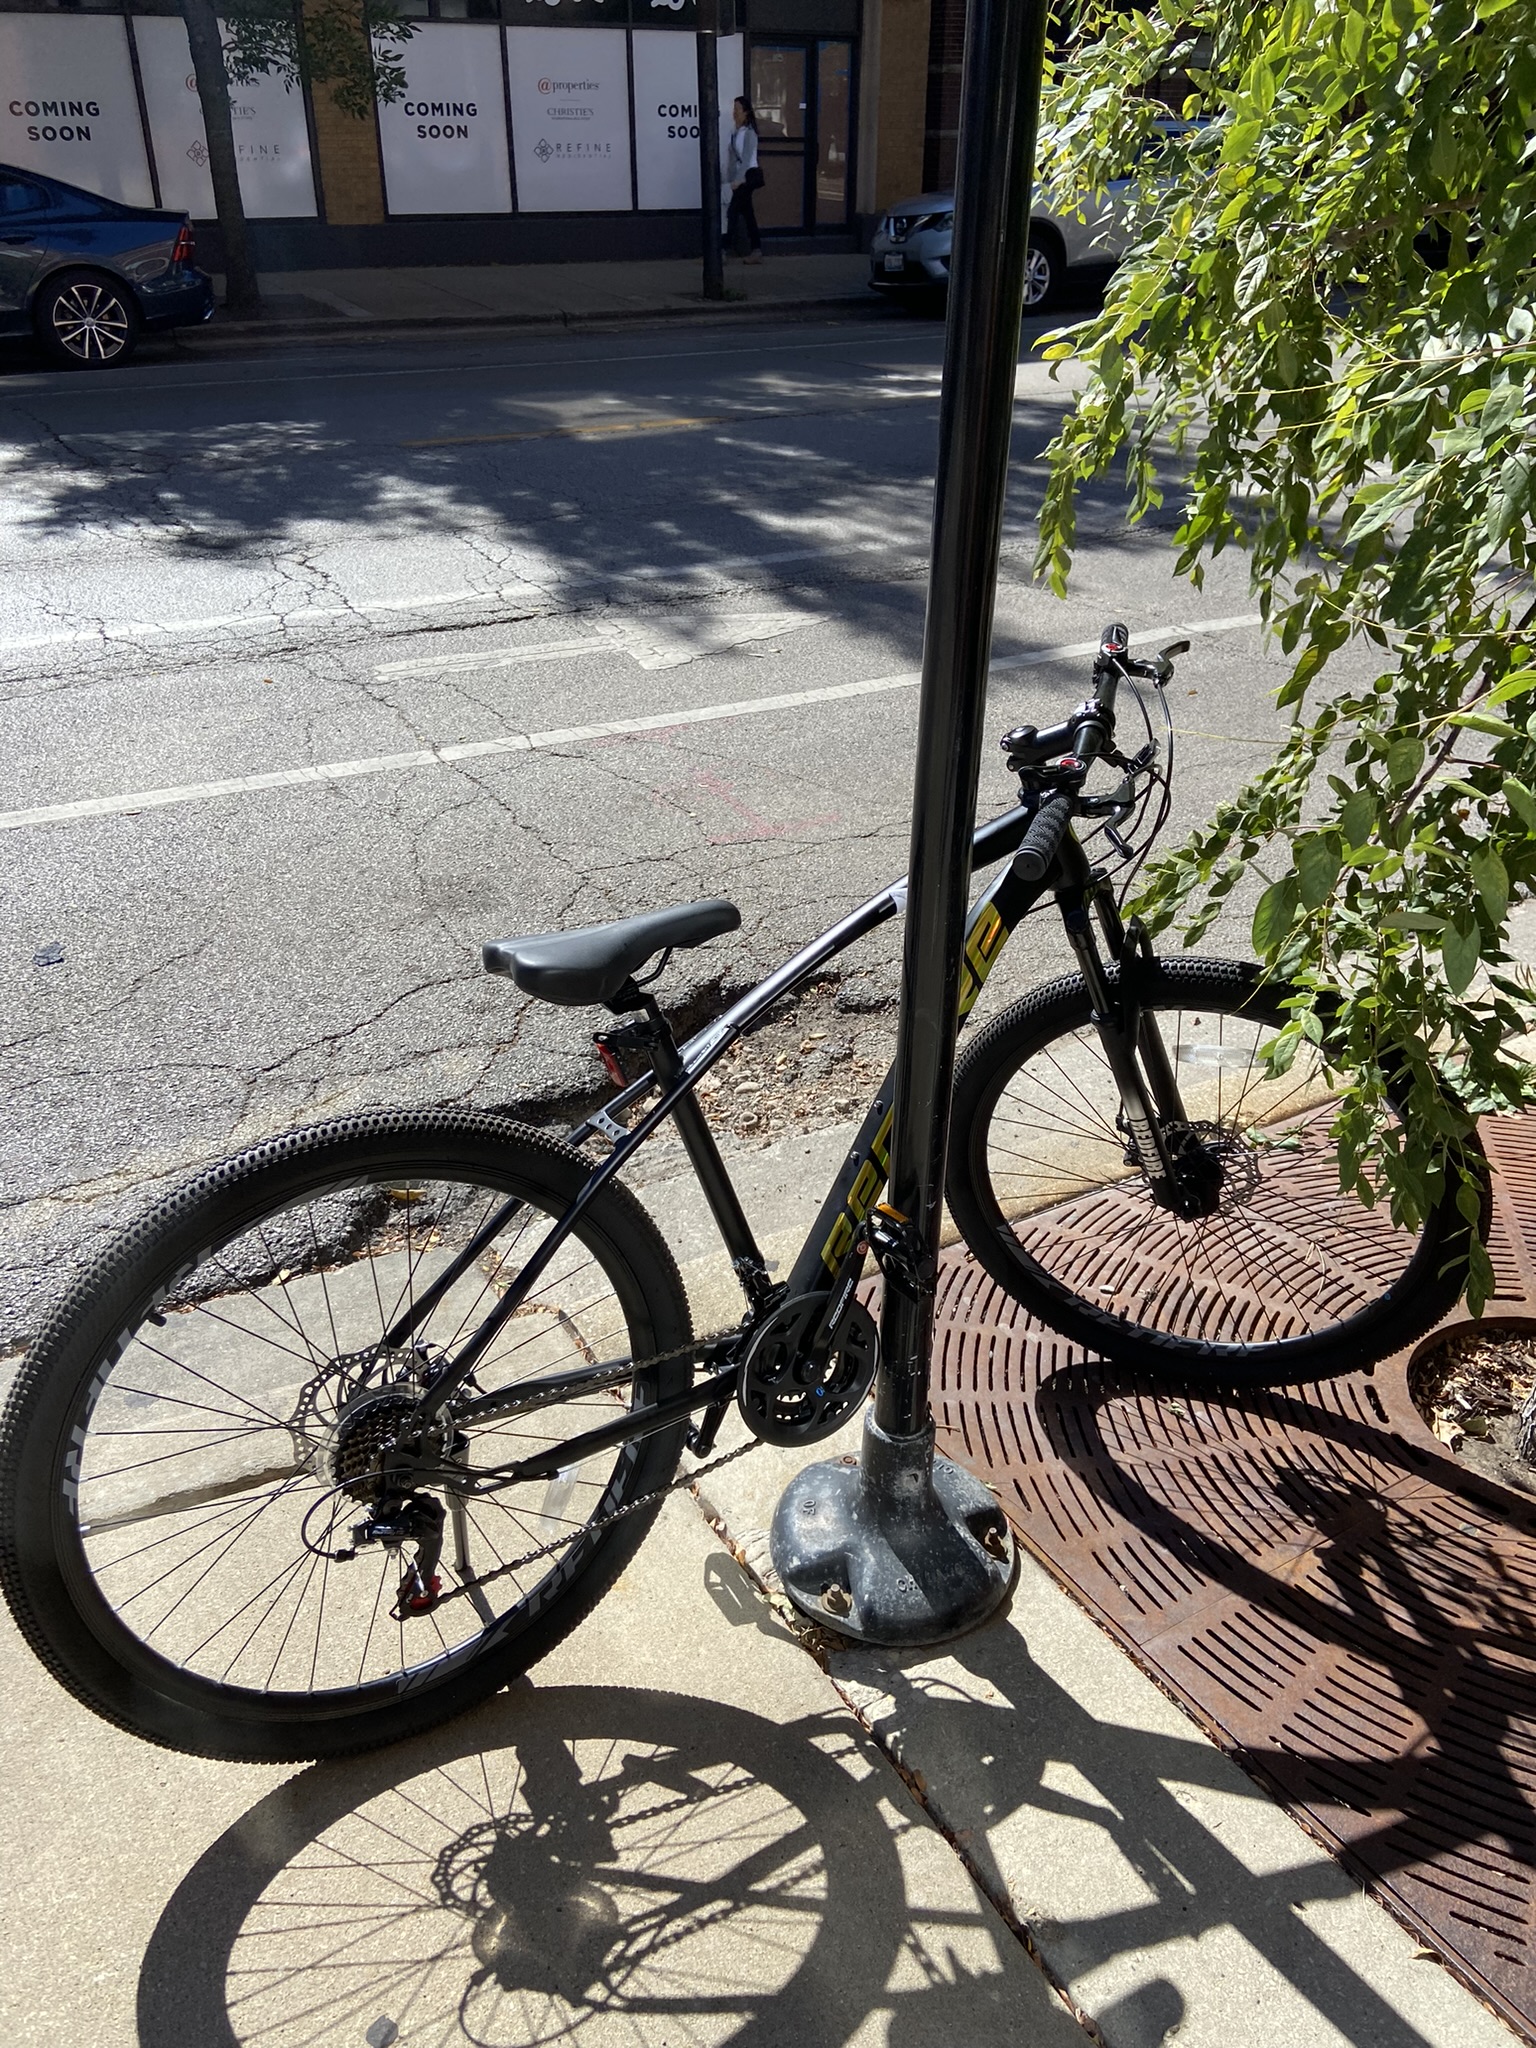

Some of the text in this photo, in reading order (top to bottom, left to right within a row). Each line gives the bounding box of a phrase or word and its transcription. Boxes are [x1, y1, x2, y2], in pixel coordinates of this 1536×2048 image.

[537, 77, 600, 95] @properties
[9, 100, 100, 117] COMING
[404, 102, 478, 117] COMING
[658, 104, 698, 118] COMI
[27, 126, 92, 141] SOON
[417, 124, 469, 139] SOON
[667, 125, 700, 139] SOO
[238, 144, 280, 155] FINE
[555, 143, 612, 153] REFINE
[1130, 1120, 1167, 1179] REDFIRE
